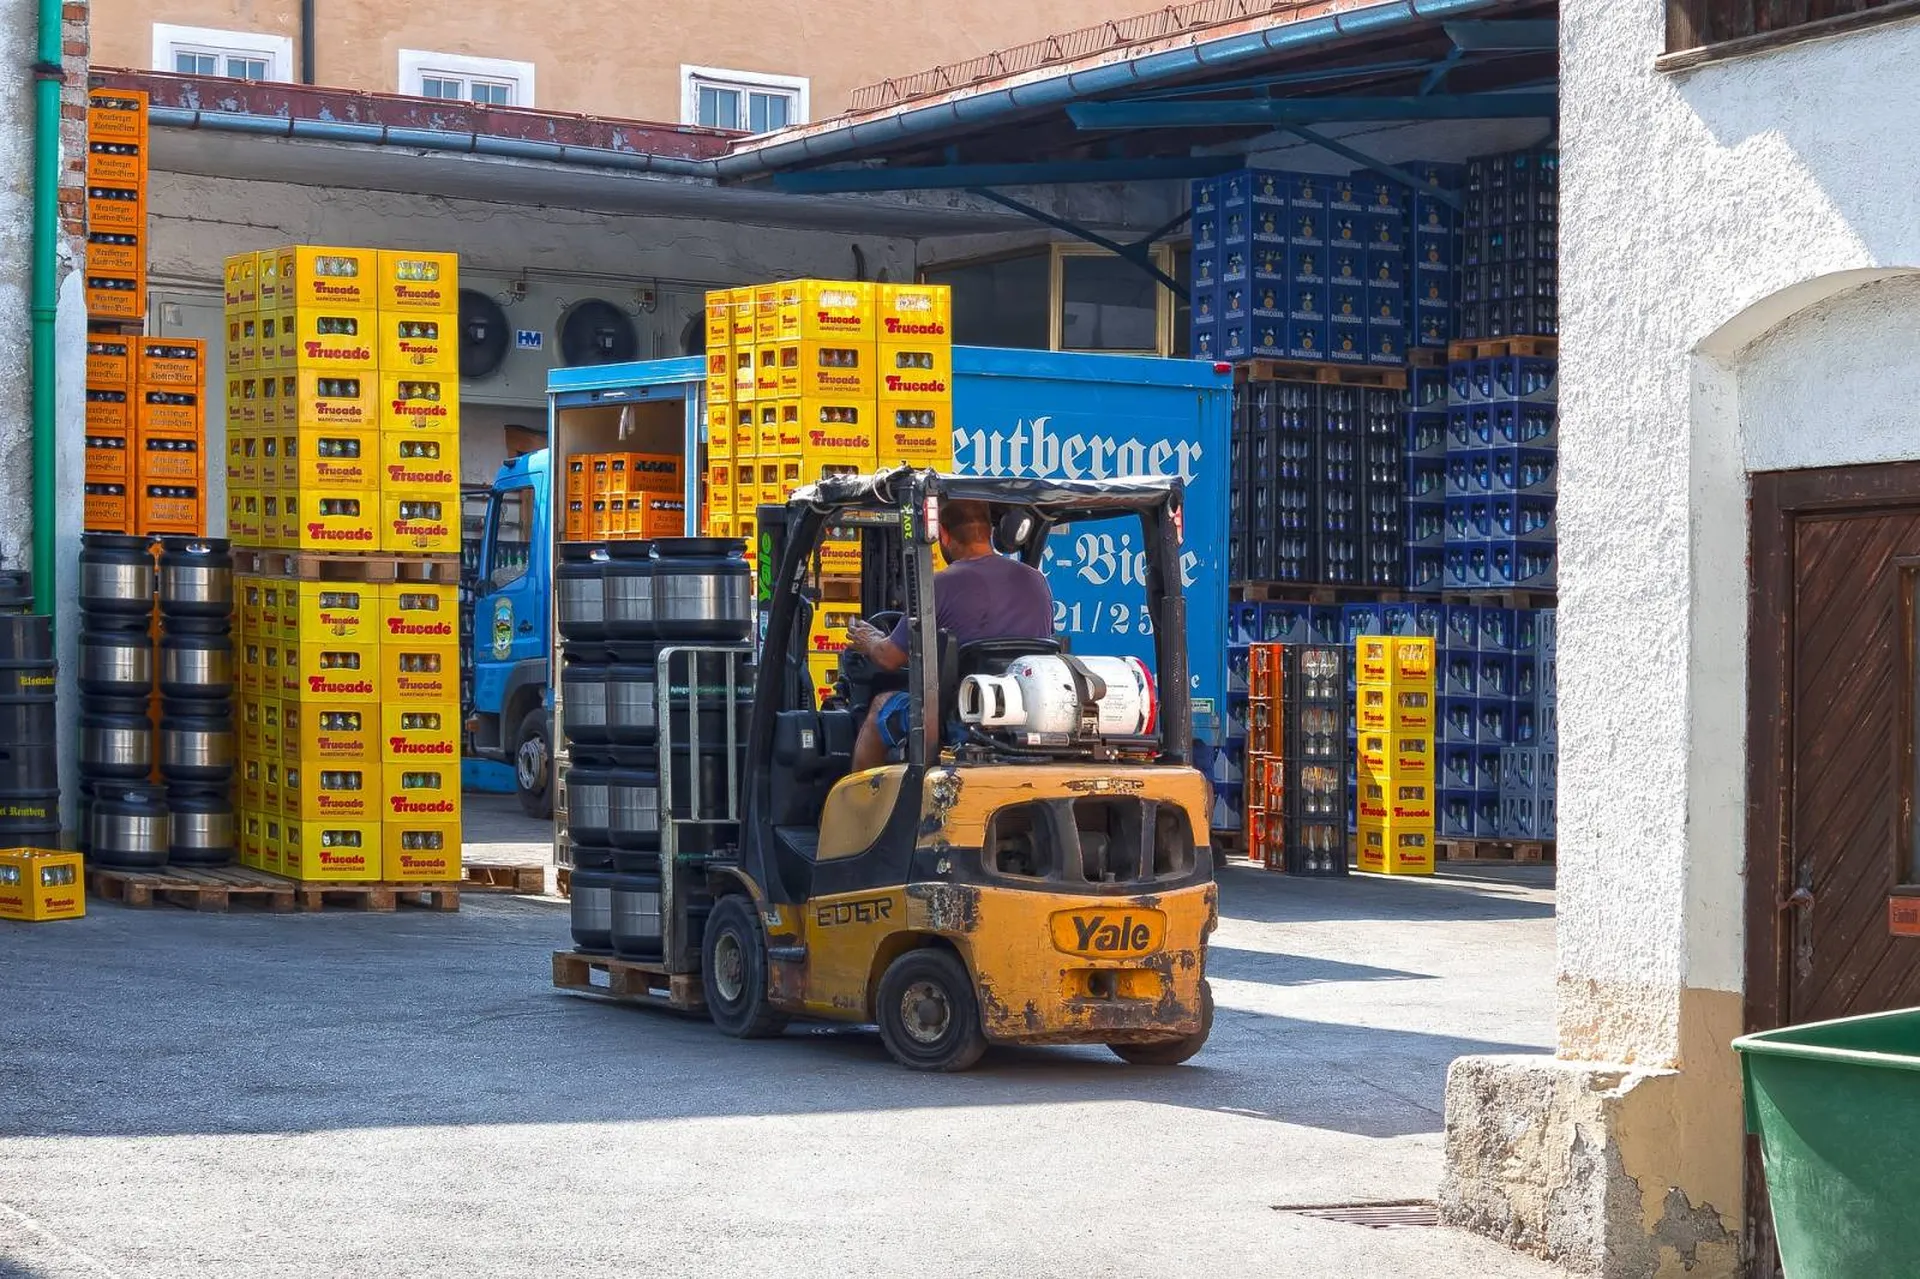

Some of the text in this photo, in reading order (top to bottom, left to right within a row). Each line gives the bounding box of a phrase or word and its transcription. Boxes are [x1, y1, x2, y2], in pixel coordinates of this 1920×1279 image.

[885, 318, 944, 335] Frucade
[305, 342, 370, 360] Frucade
[886, 376, 945, 392] Frucade
[392, 401, 446, 416] Frucade
[809, 430, 869, 447] Frucade
[388, 466, 452, 482] Frucade
[307, 523, 372, 541] Frucade
[393, 521, 447, 535] Frucade
[387, 618, 451, 634] Frucade
[308, 676, 372, 693] Frucade
[390, 737, 453, 754] Frucade
[391, 797, 453, 812] Frucade
[817, 897, 893, 927] EDER
[1073, 915, 1150, 951] Yale
